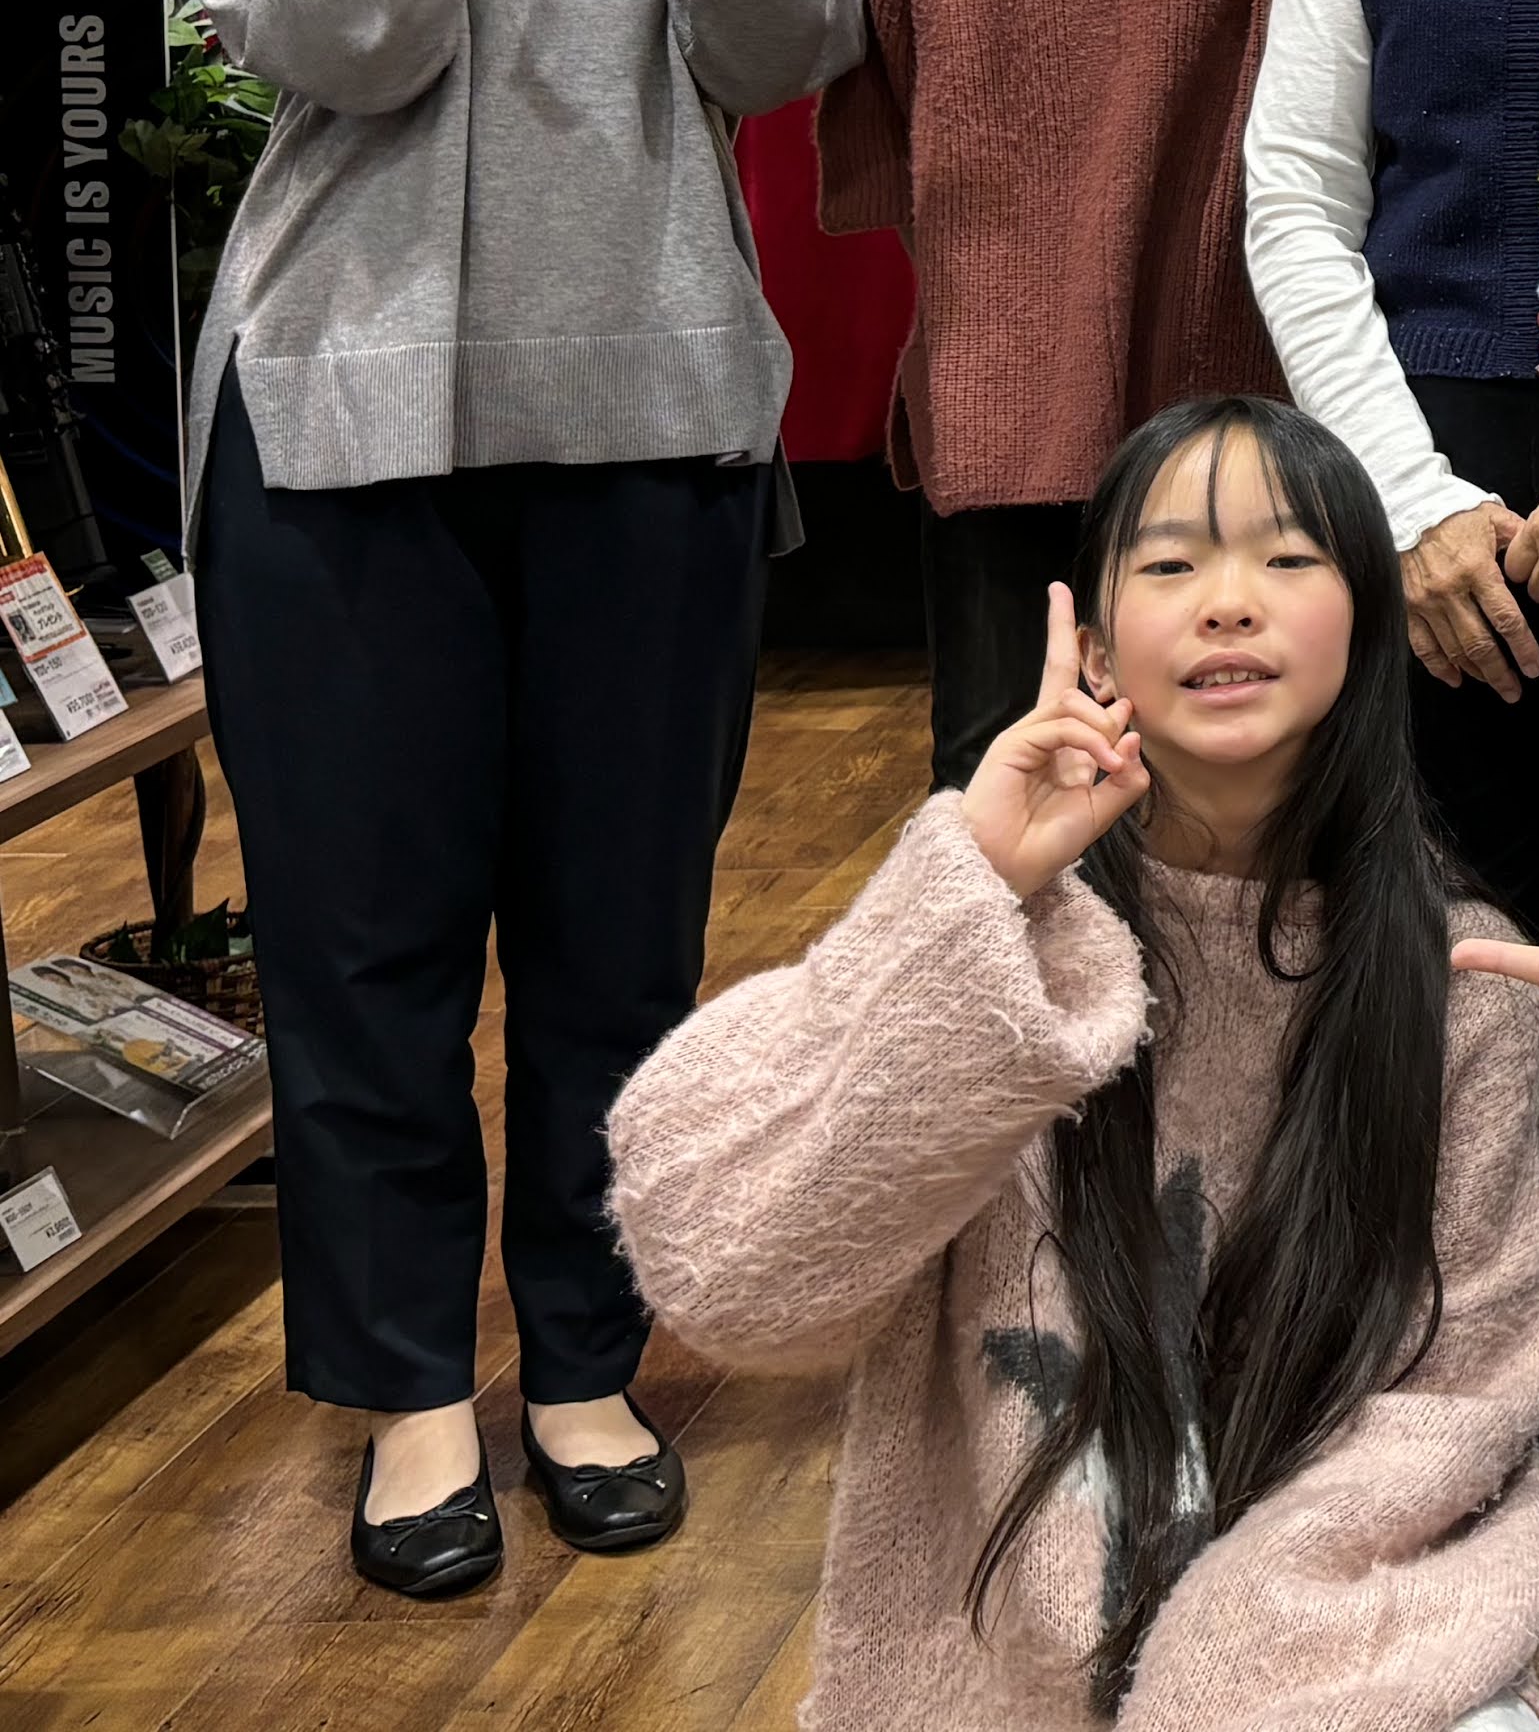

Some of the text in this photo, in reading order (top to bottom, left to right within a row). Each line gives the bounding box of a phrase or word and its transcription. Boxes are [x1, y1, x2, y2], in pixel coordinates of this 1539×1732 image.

[59, 13, 116, 384] MUSIC IS YOURS
